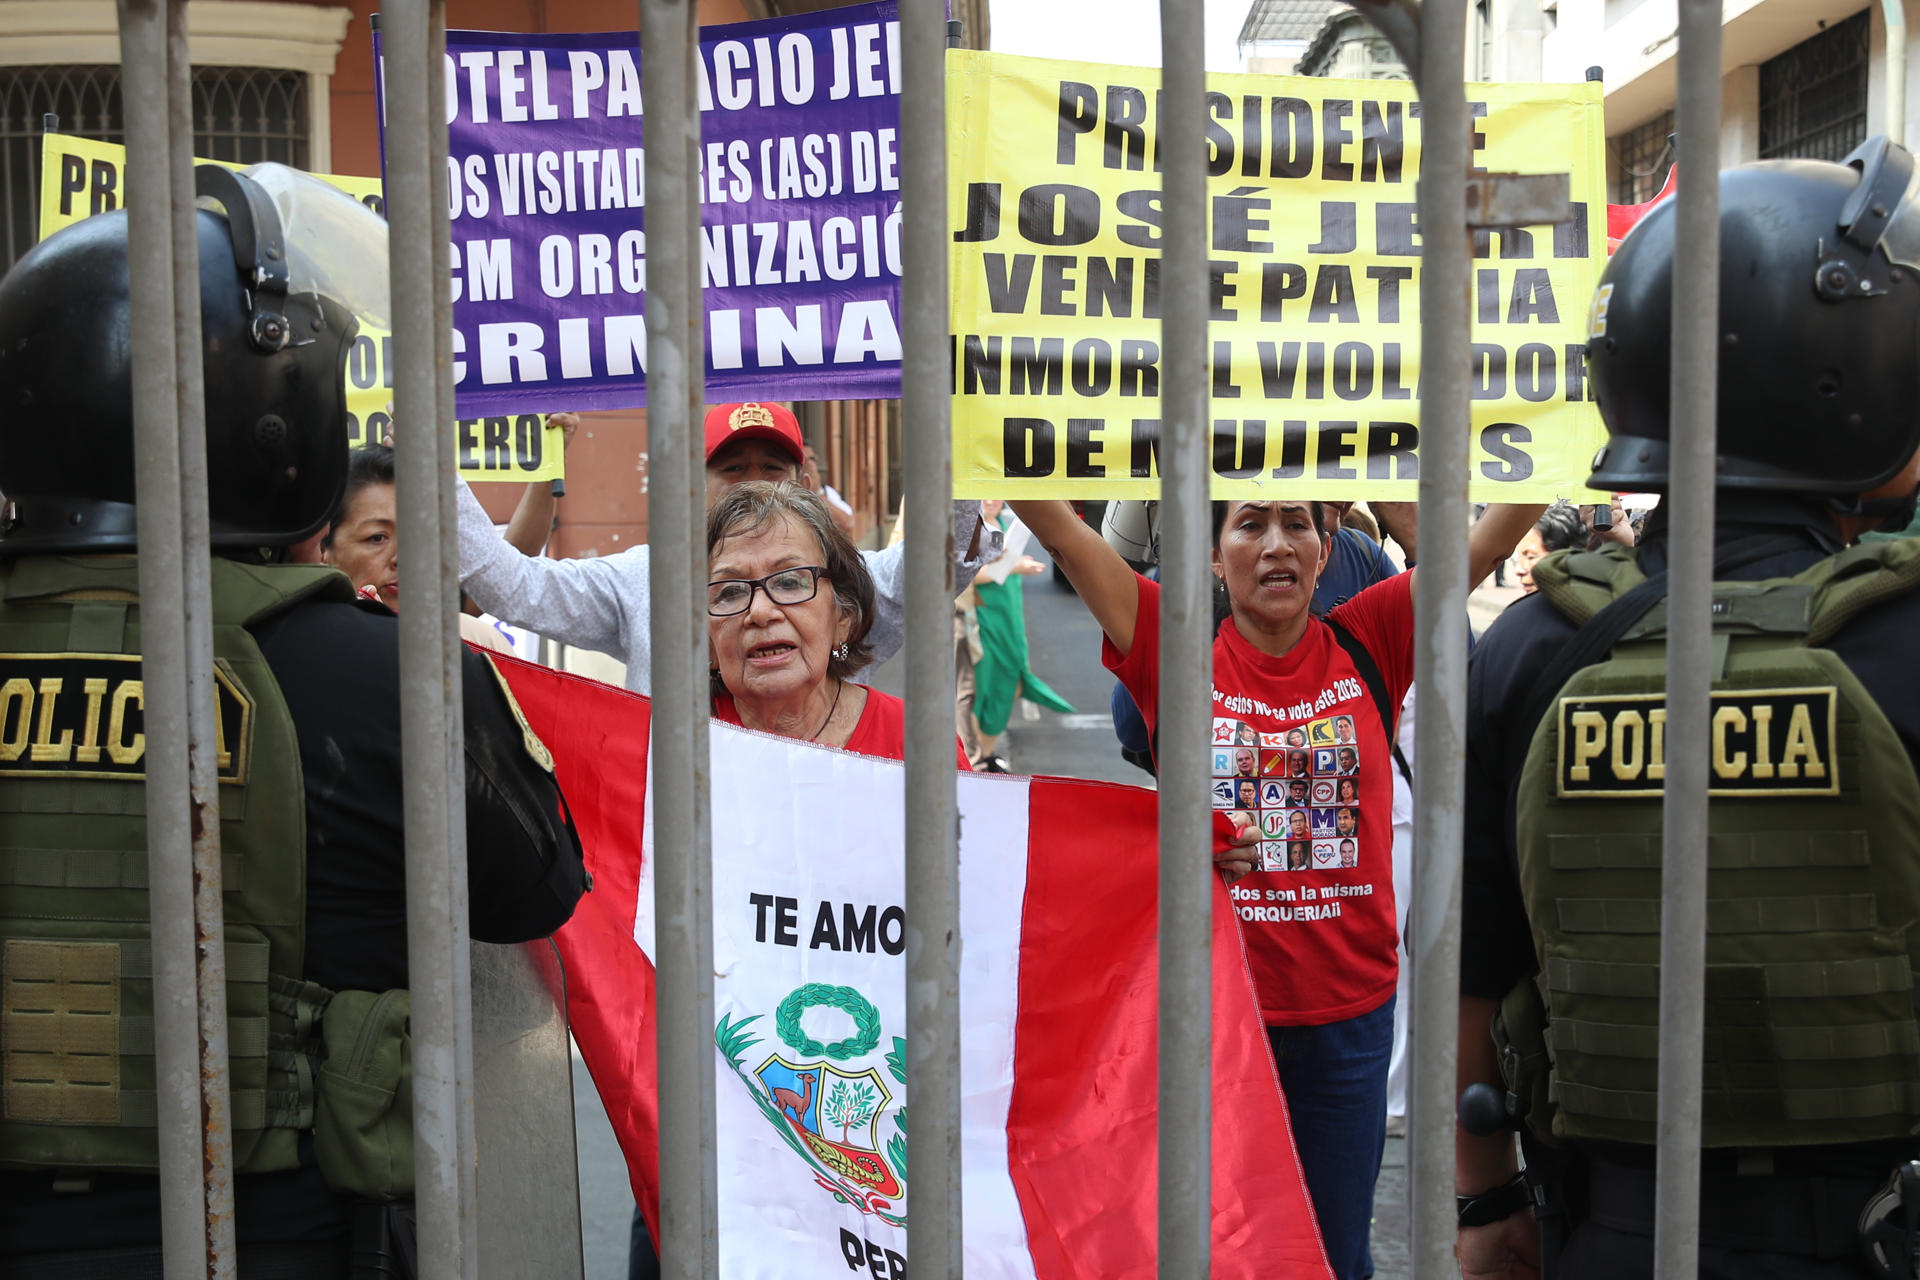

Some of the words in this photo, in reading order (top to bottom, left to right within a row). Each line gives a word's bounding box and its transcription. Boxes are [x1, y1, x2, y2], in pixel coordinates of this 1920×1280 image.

[380, 50, 558, 127] TEL
[569, 33, 815, 119] PACIO
[830, 21, 901, 101] JE
[447, 154, 489, 220] OS
[494, 139, 753, 216] VISITADES
[539, 201, 904, 299] ORGNIZACIÓ
[953, 183, 1274, 254] JOSÉ
[1261, 263, 1560, 324] PATIA
[451, 300, 904, 386] RIINA
[949, 335, 1241, 398] NMORL
[1256, 341, 1594, 402] VIOLDOR
[1003, 418, 1106, 479] DE
[1131, 419, 1534, 482] UJERS
[0, 678, 231, 768] OLIC
[1225, 693, 1253, 714] estos
[1253, 700, 1272, 717] NO
[1272, 707, 1287, 721] se
[1288, 699, 1314, 721] vota
[1315, 688, 1337, 713] este
[1334, 678, 1362, 701] 2026
[1215, 754, 1228, 770] R
[1318, 751, 1333, 771] P
[1570, 704, 1825, 781] POCIA
[1265, 784, 1280, 800] A
[750, 893, 798, 947] TE
[809, 900, 906, 956] AMO
[1266, 889, 1297, 902] son
[1301, 885, 1317, 901] la
[1320, 884, 1372, 898] misma
[840, 1227, 907, 1280] PER
